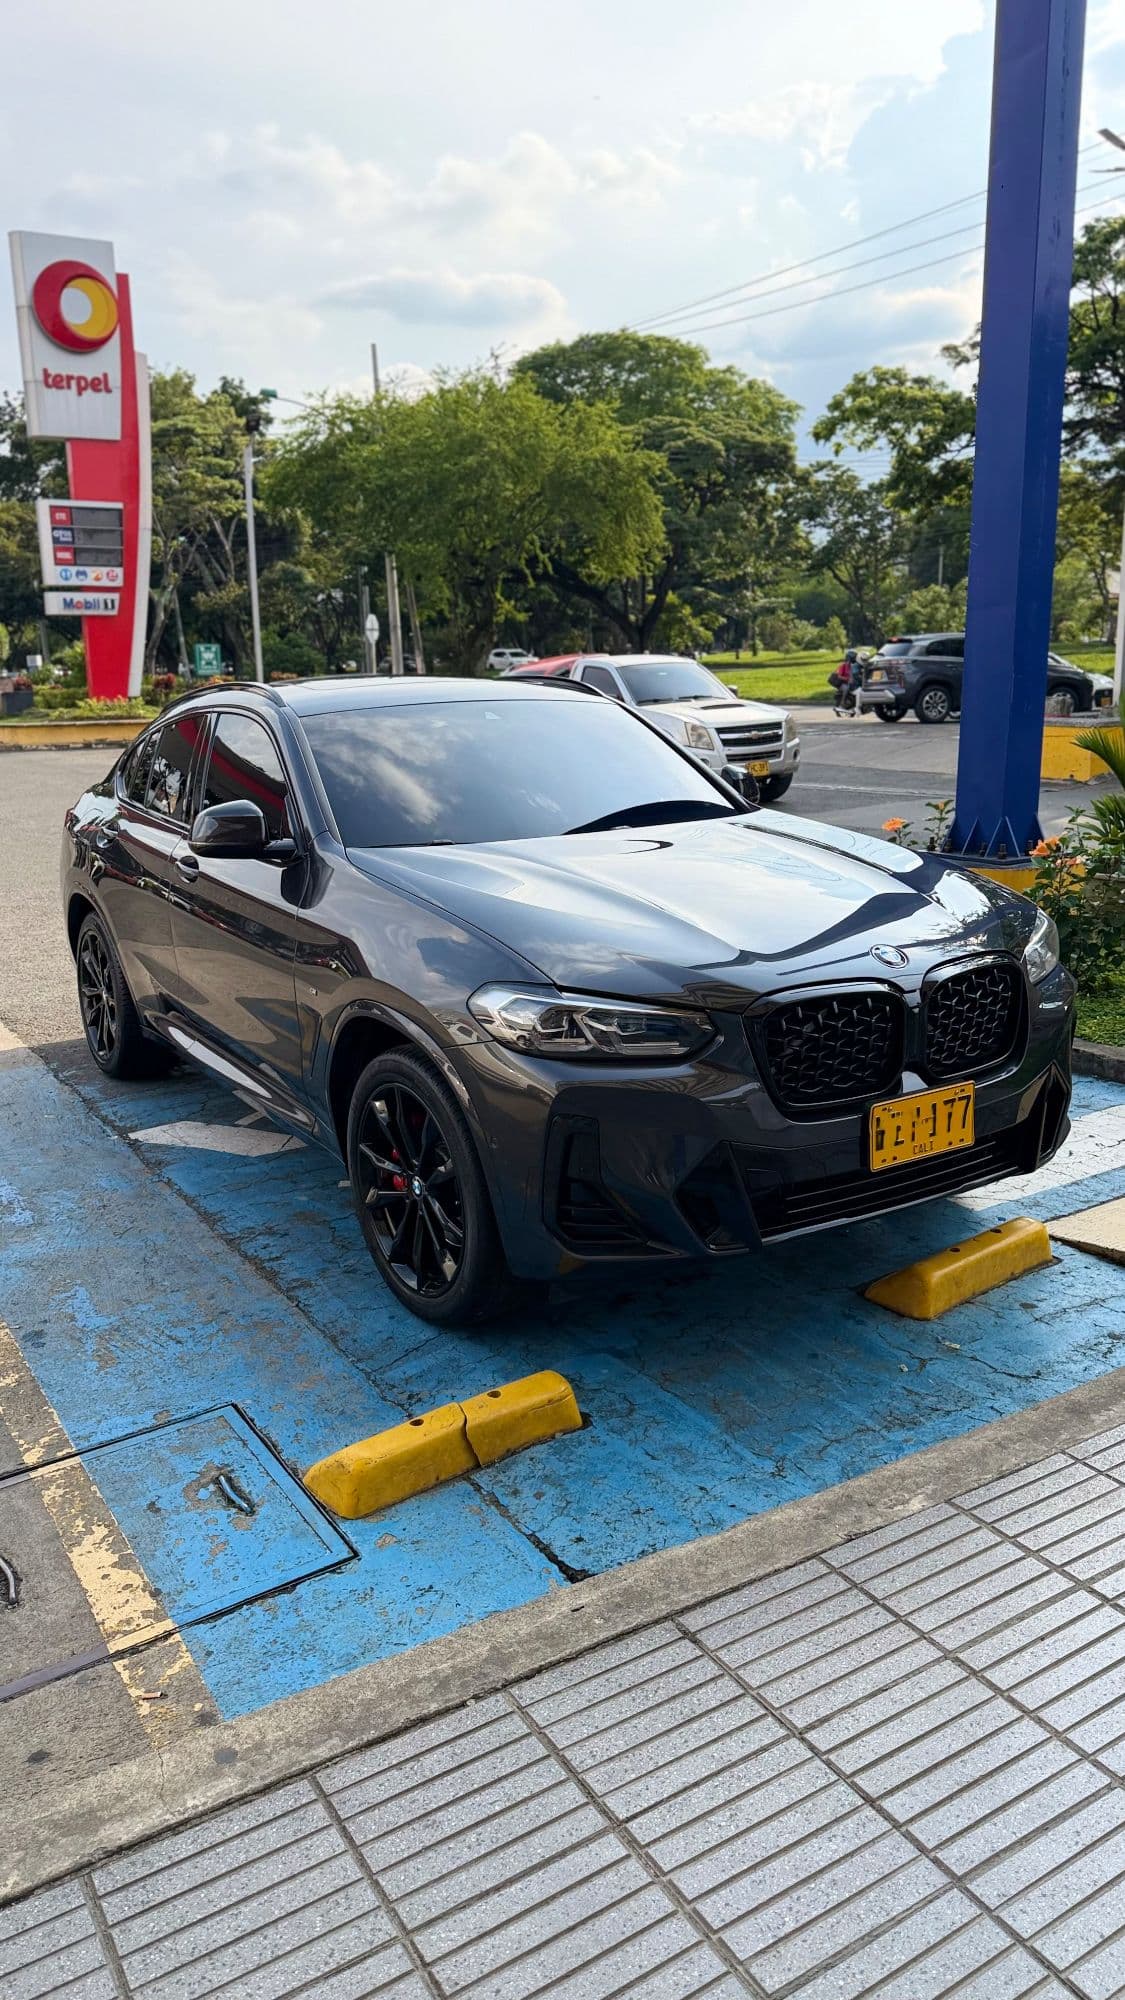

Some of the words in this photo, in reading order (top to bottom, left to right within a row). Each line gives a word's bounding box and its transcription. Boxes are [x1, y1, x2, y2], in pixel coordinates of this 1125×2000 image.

[43, 368, 112, 396] terpel
[63, 598, 100, 610] Mobil
[912, 1140, 934, 1155] CALI
